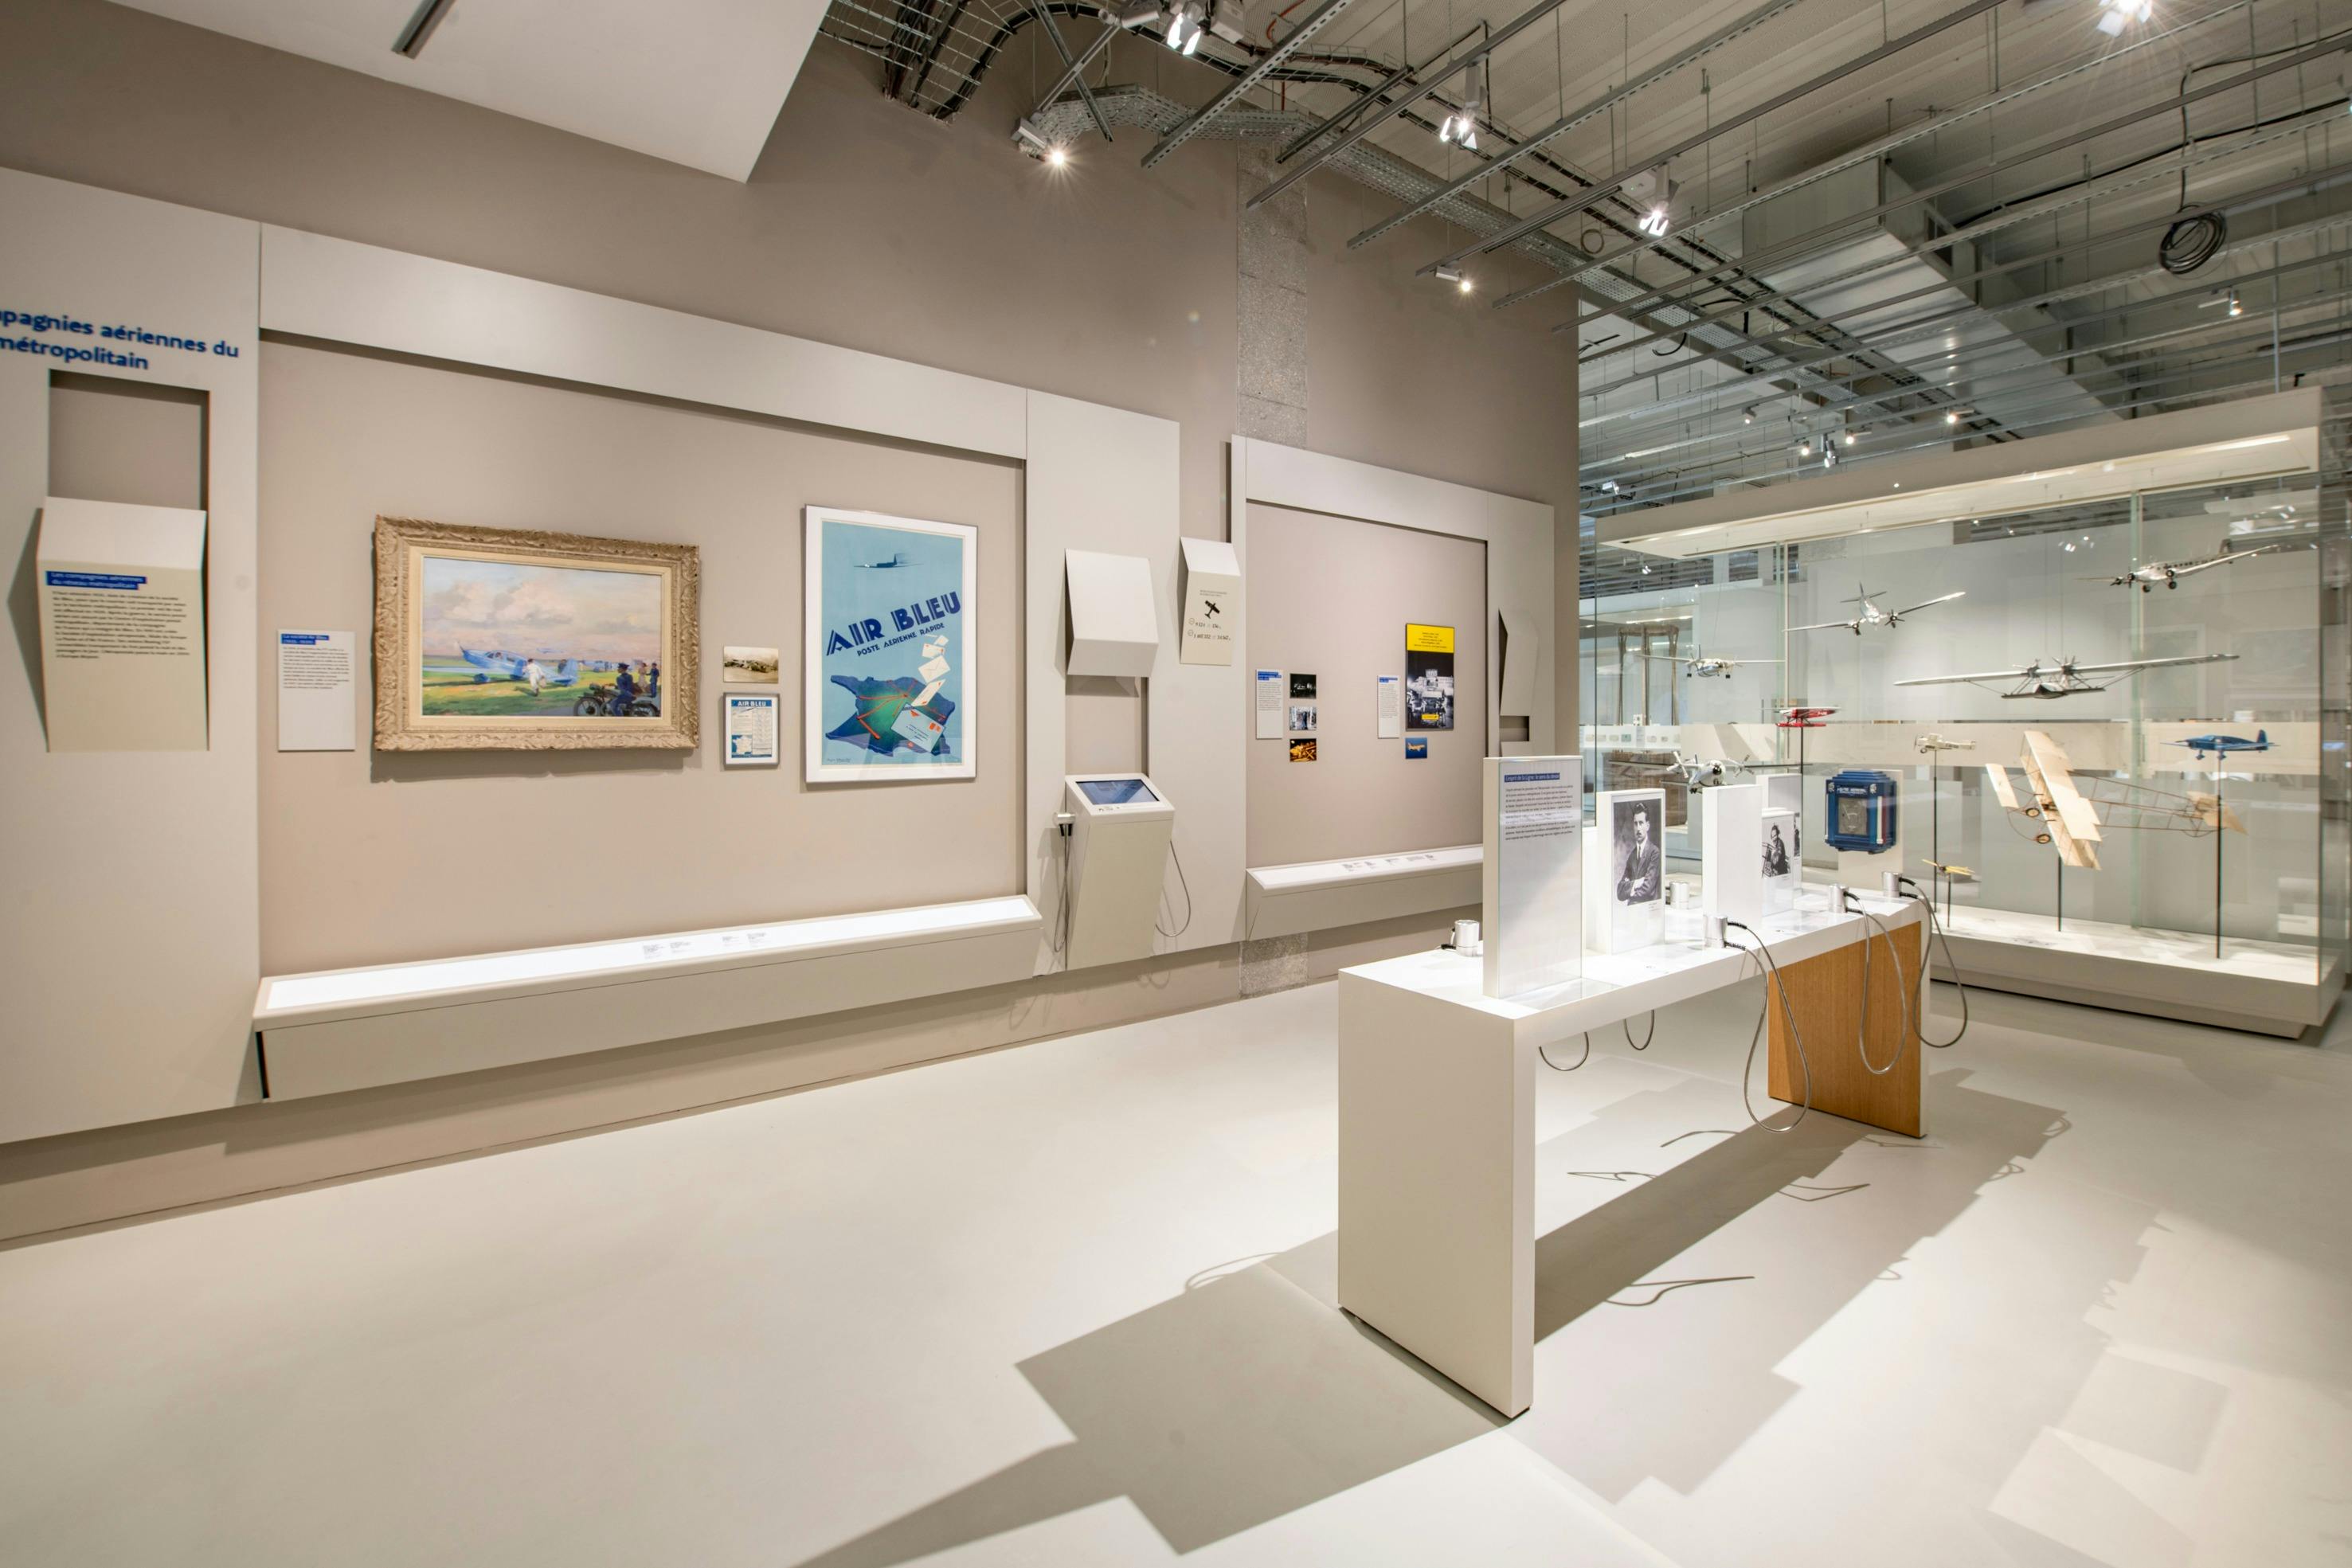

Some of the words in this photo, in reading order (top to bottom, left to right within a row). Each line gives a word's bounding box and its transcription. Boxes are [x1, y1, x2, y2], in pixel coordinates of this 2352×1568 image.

[0, 311, 94, 335] pagnies
[101, 325, 207, 353] aériennes
[213, 341, 239, 358] du
[0, 337, 149, 370] métropolitain
[826, 618, 885, 656] AIR
[890, 591, 961, 632] BLEU
[857, 643, 880, 657] POSTE
[883, 632, 918, 648] AERIENNE
[919, 622, 945, 636] RAPIDE
